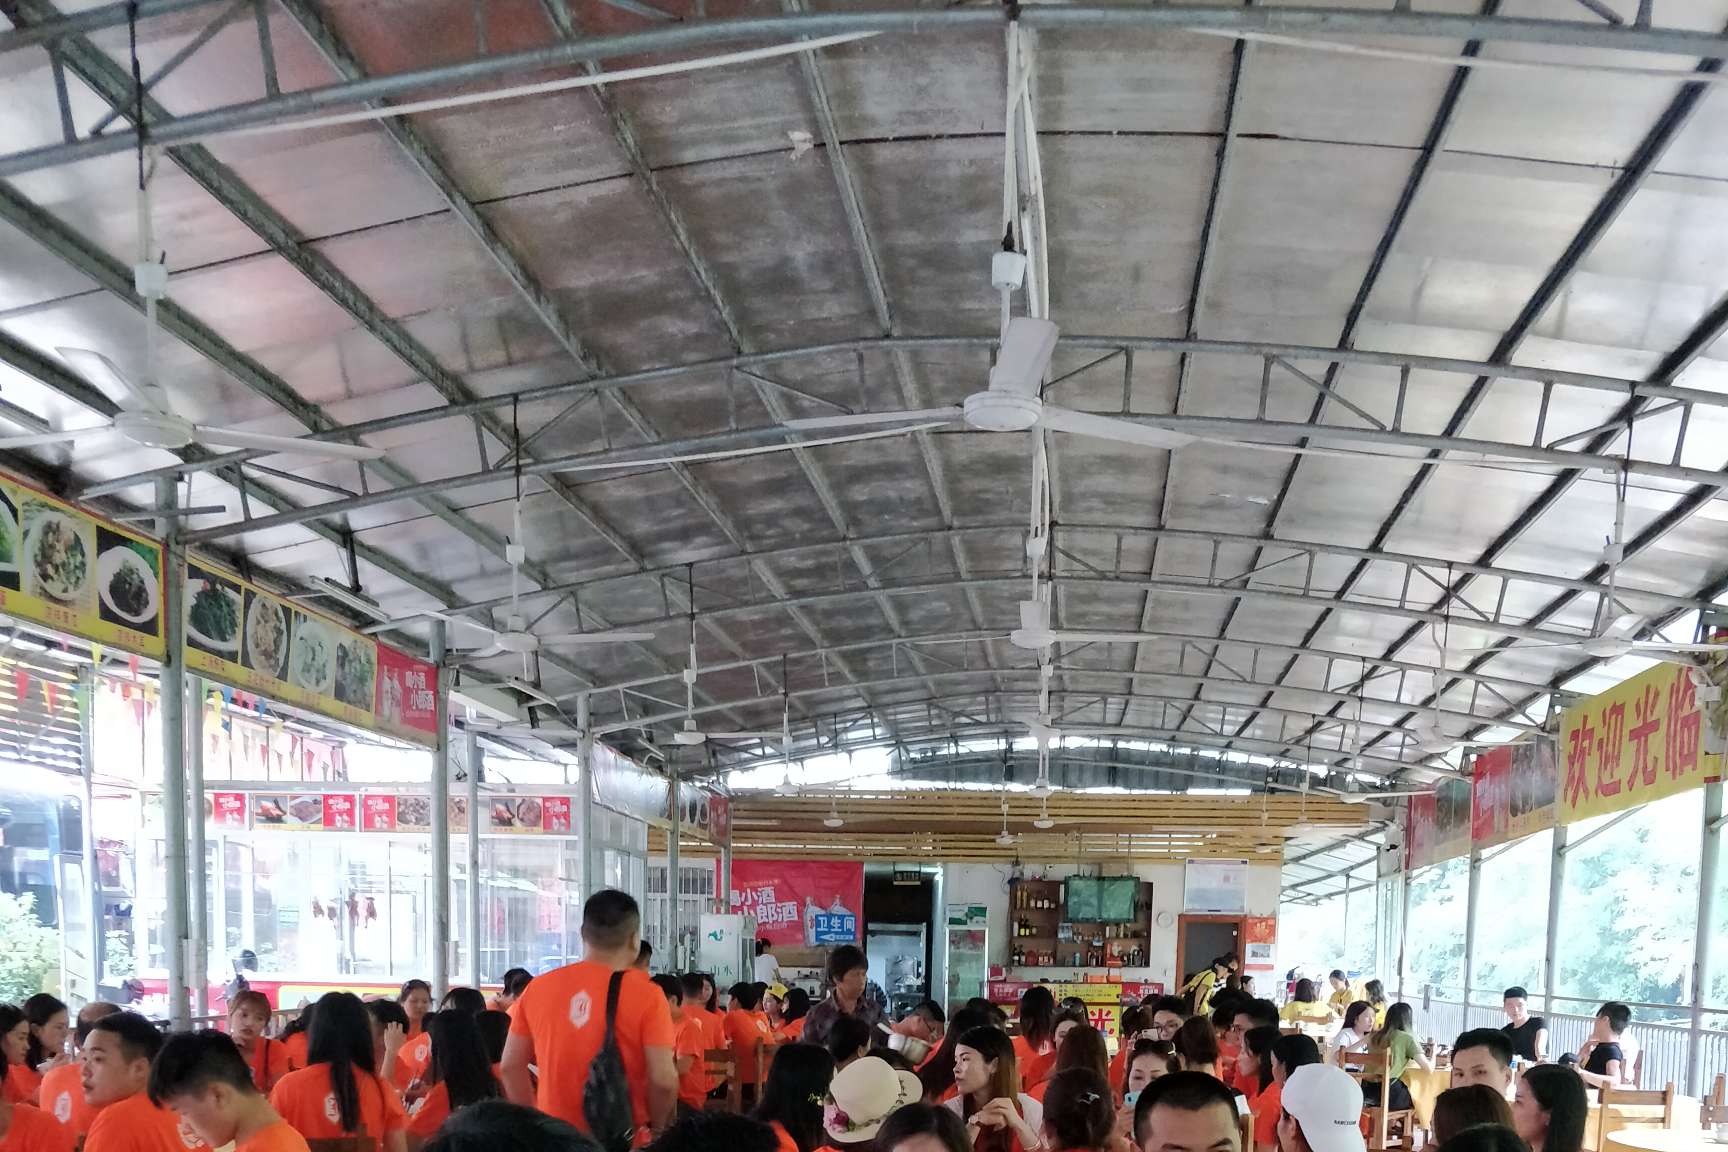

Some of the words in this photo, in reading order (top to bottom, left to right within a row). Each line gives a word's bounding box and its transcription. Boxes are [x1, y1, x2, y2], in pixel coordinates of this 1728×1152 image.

[1563, 666, 1700, 808] 欢迎光临
[816, 915, 856, 933] 卫生间
